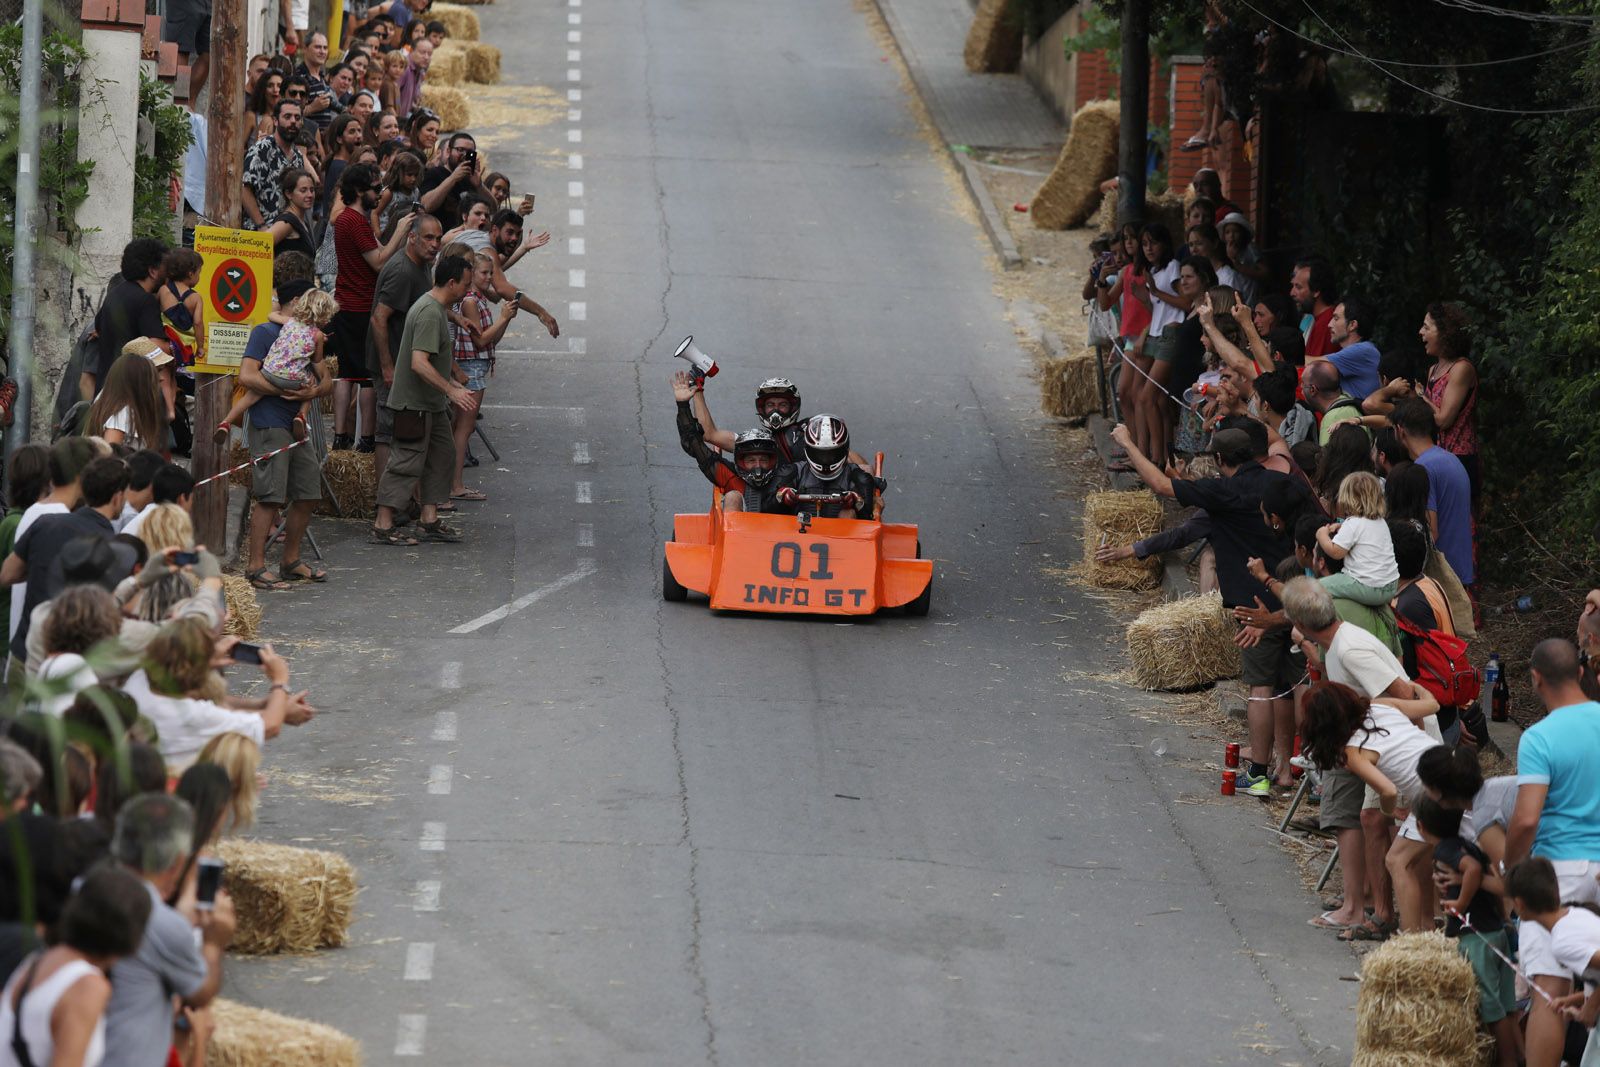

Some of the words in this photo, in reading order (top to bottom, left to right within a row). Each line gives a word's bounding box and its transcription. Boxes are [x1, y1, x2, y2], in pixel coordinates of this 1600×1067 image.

[199, 232, 231, 242] Ajuntament
[196, 243, 238, 256] Senyalització
[239, 249, 272, 260] excepcional
[771, 542, 833, 580] 01
[744, 584, 809, 606] INFO
[825, 589, 867, 607] GT
